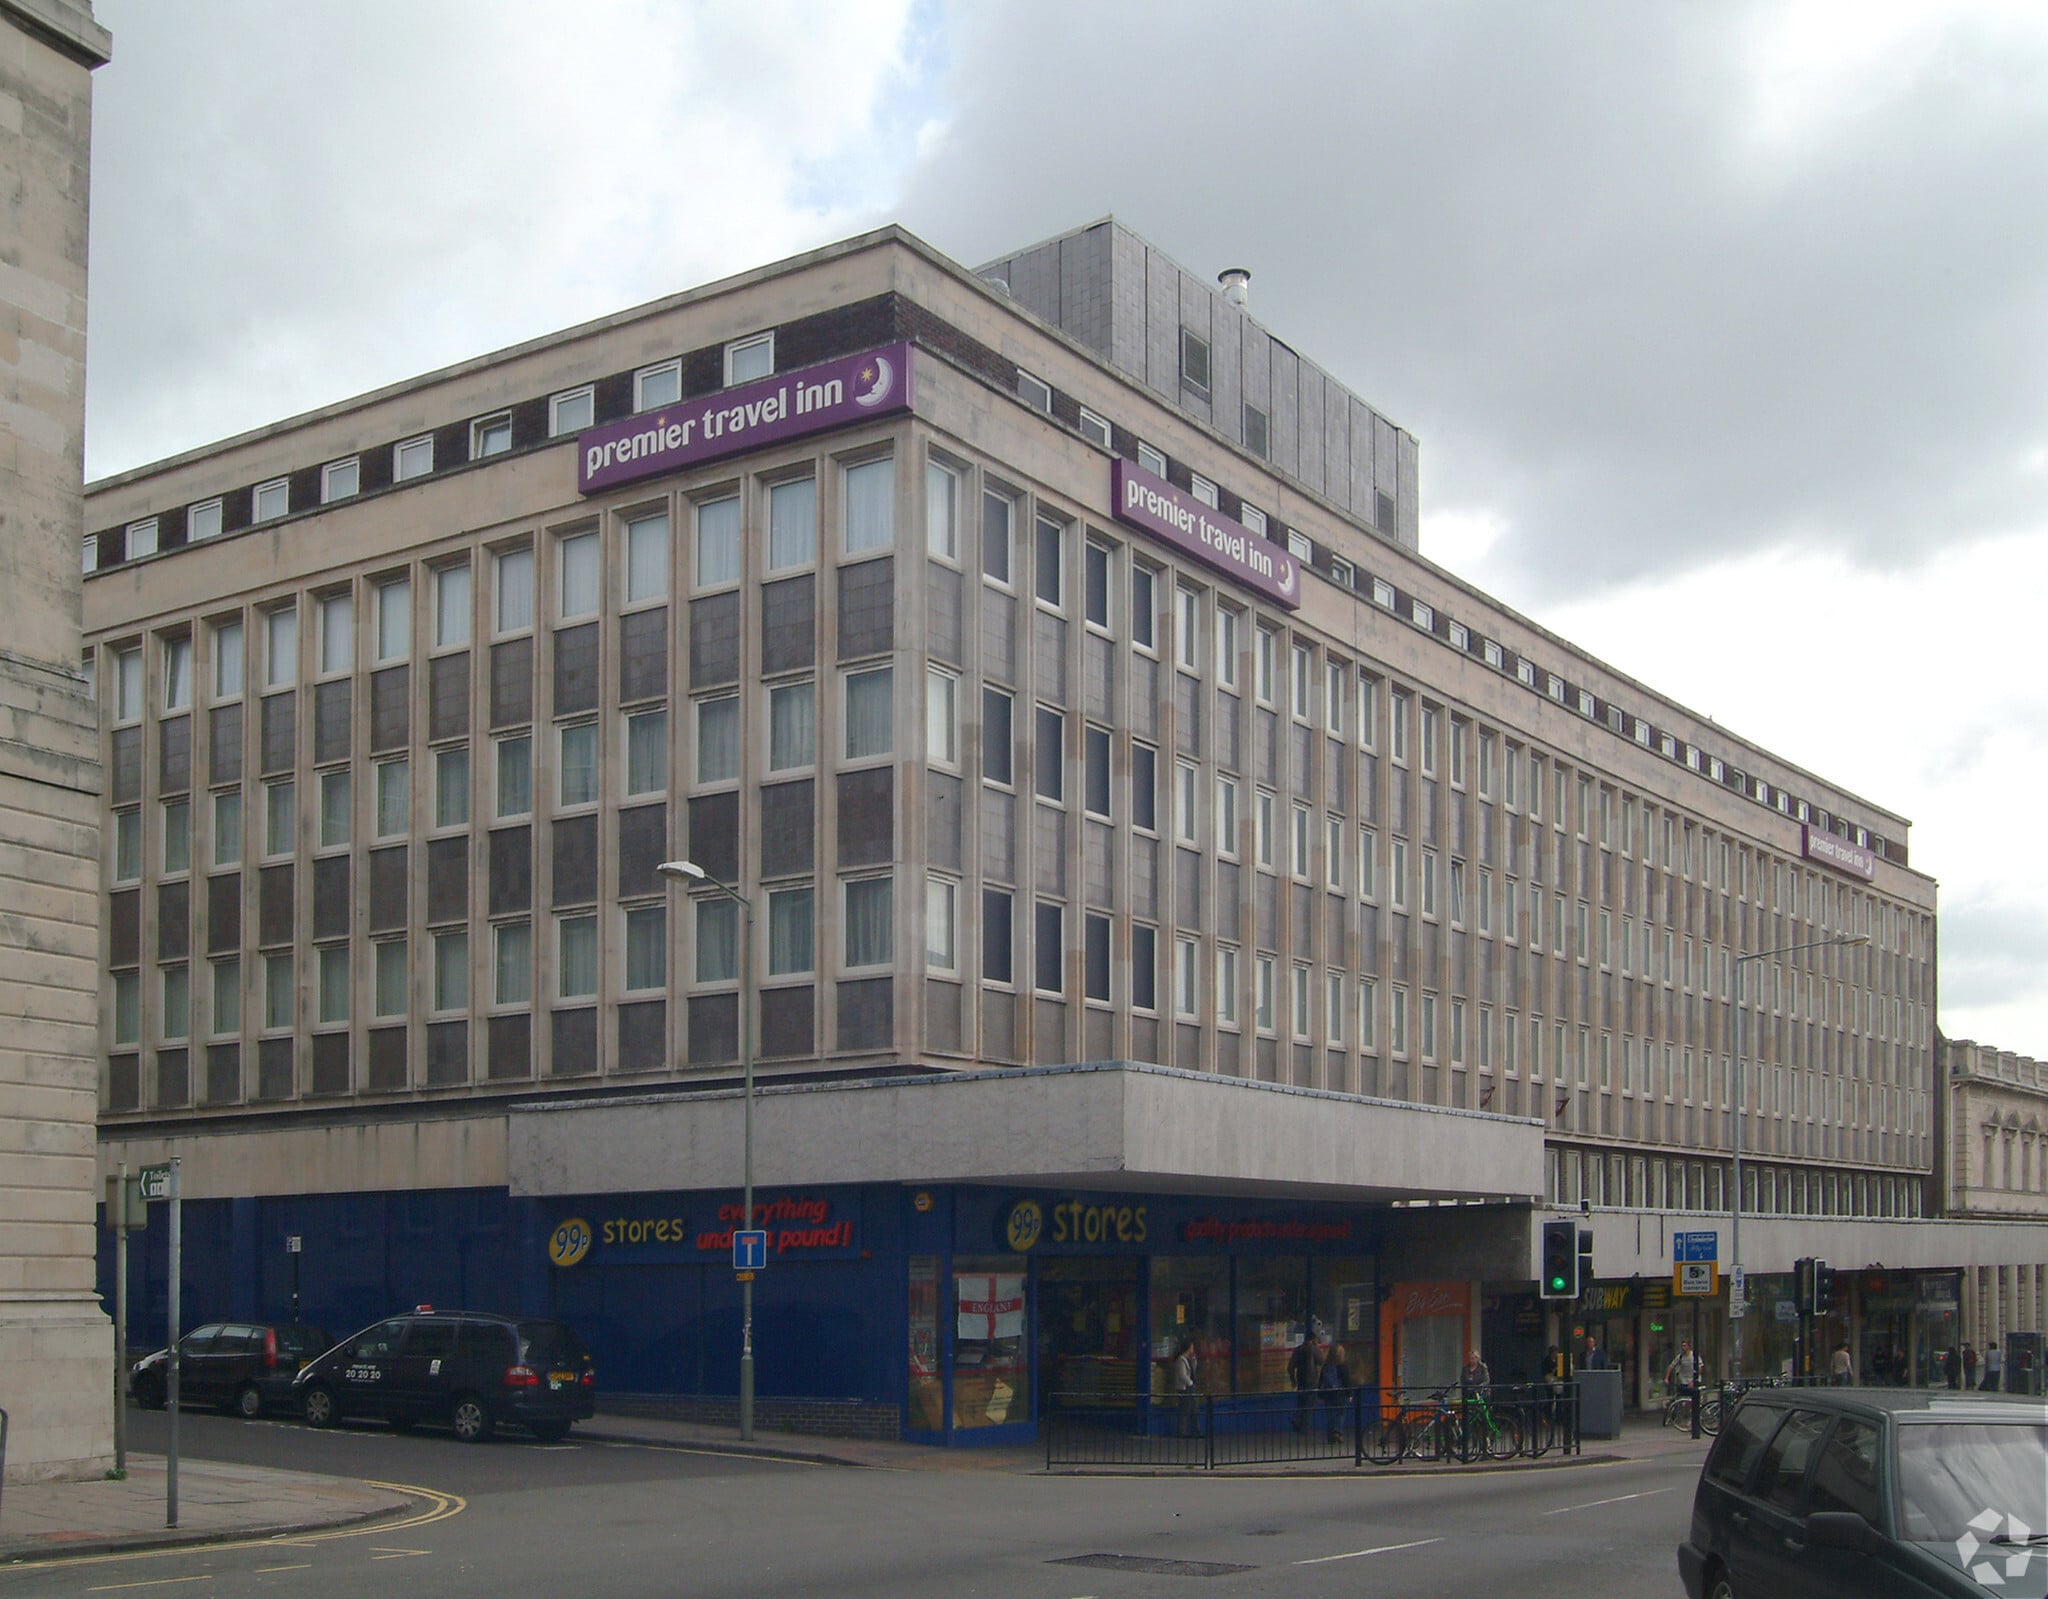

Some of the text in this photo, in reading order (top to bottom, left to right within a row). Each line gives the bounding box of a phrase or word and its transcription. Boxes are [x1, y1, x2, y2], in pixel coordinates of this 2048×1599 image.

[586, 379, 843, 480] premier travel inn
[1127, 479, 1272, 578] premier travel inn
[1810, 835, 1835, 856] premier
[1835, 843, 1853, 865] travel
[555, 1217, 684, 1260] 99p stores
[776, 1222, 853, 1255] pound!
[1012, 1199, 1148, 1244] 99p stores
[1582, 1286, 1630, 1310] SUBWAY
[345, 1369, 381, 1380] 20 20 20
